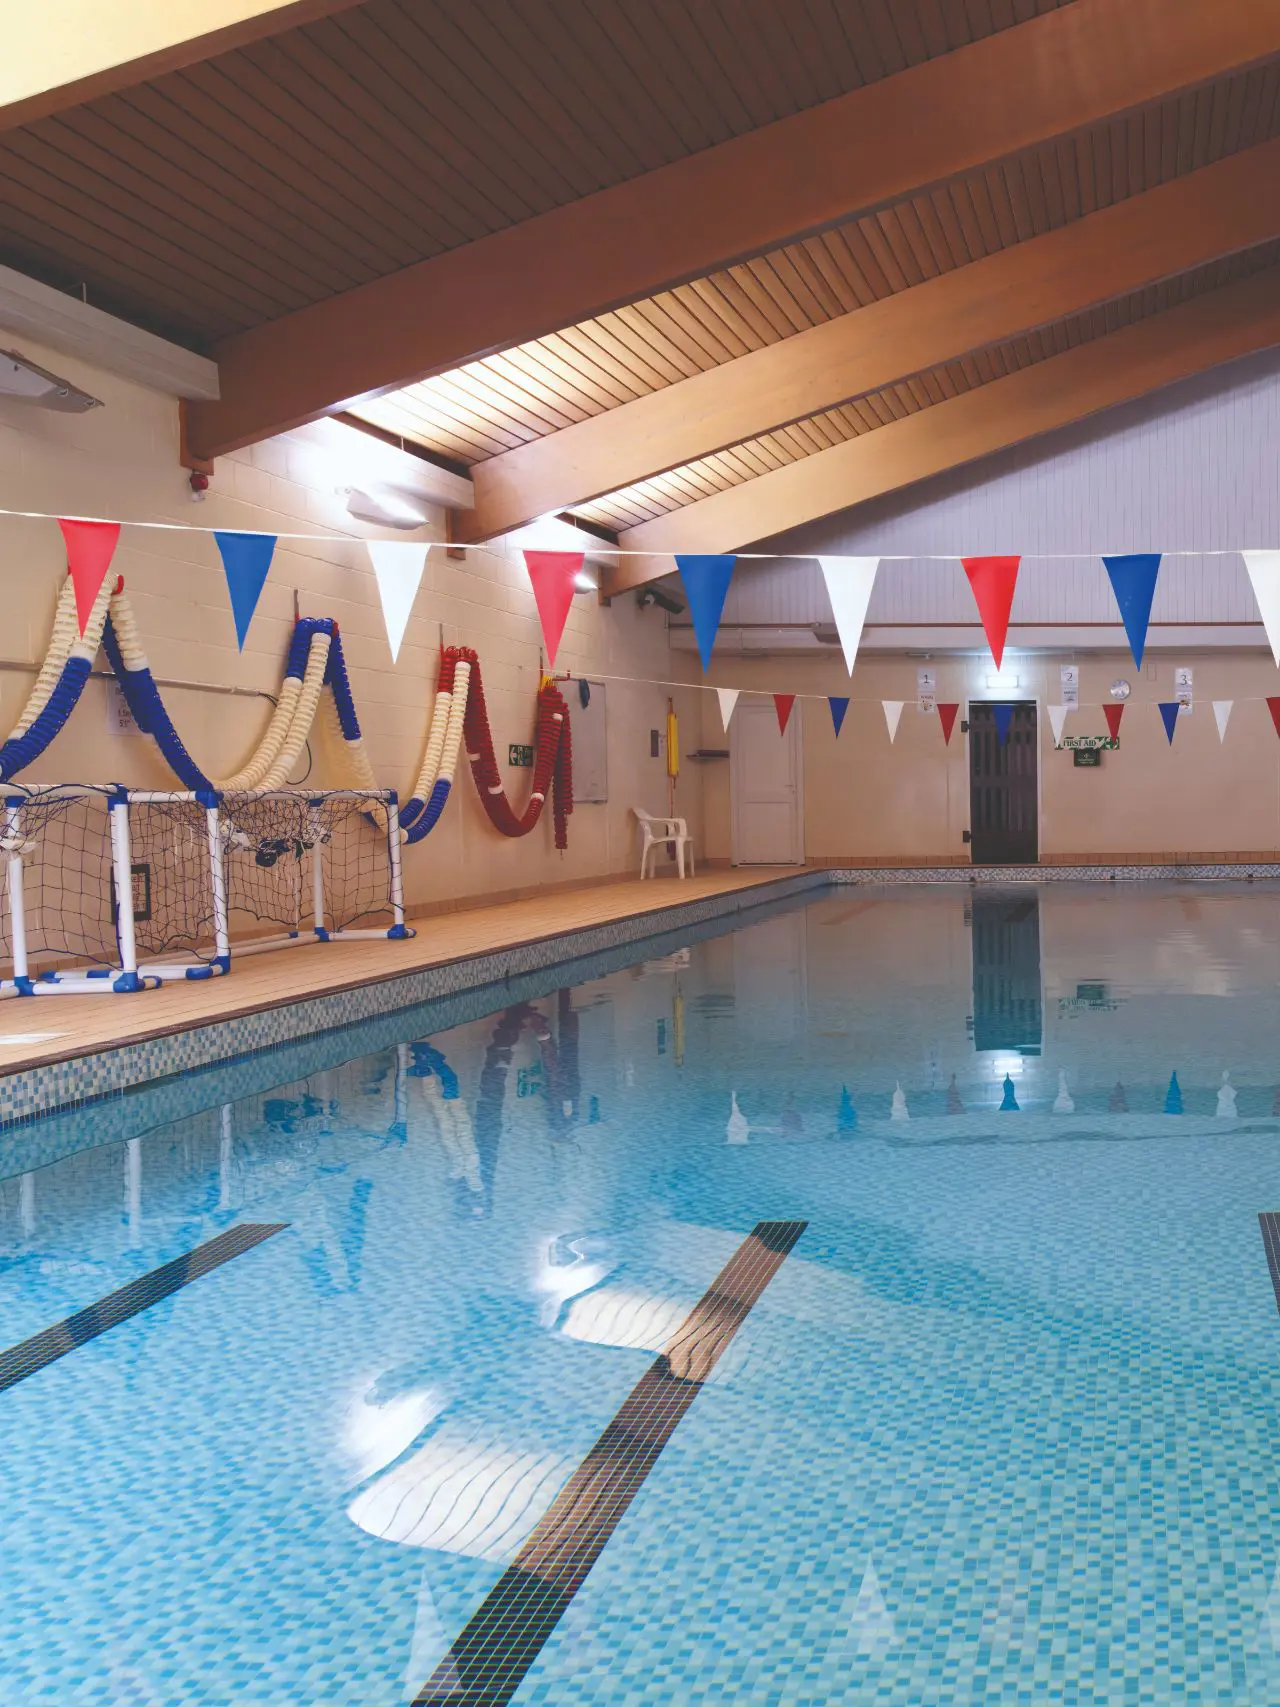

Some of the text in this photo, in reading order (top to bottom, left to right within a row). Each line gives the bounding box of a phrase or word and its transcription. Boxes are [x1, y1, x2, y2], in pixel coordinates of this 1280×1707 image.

[923, 674, 930, 684] 1
[1066, 672, 1073, 682] 2
[1180, 674, 1188, 686] 3
